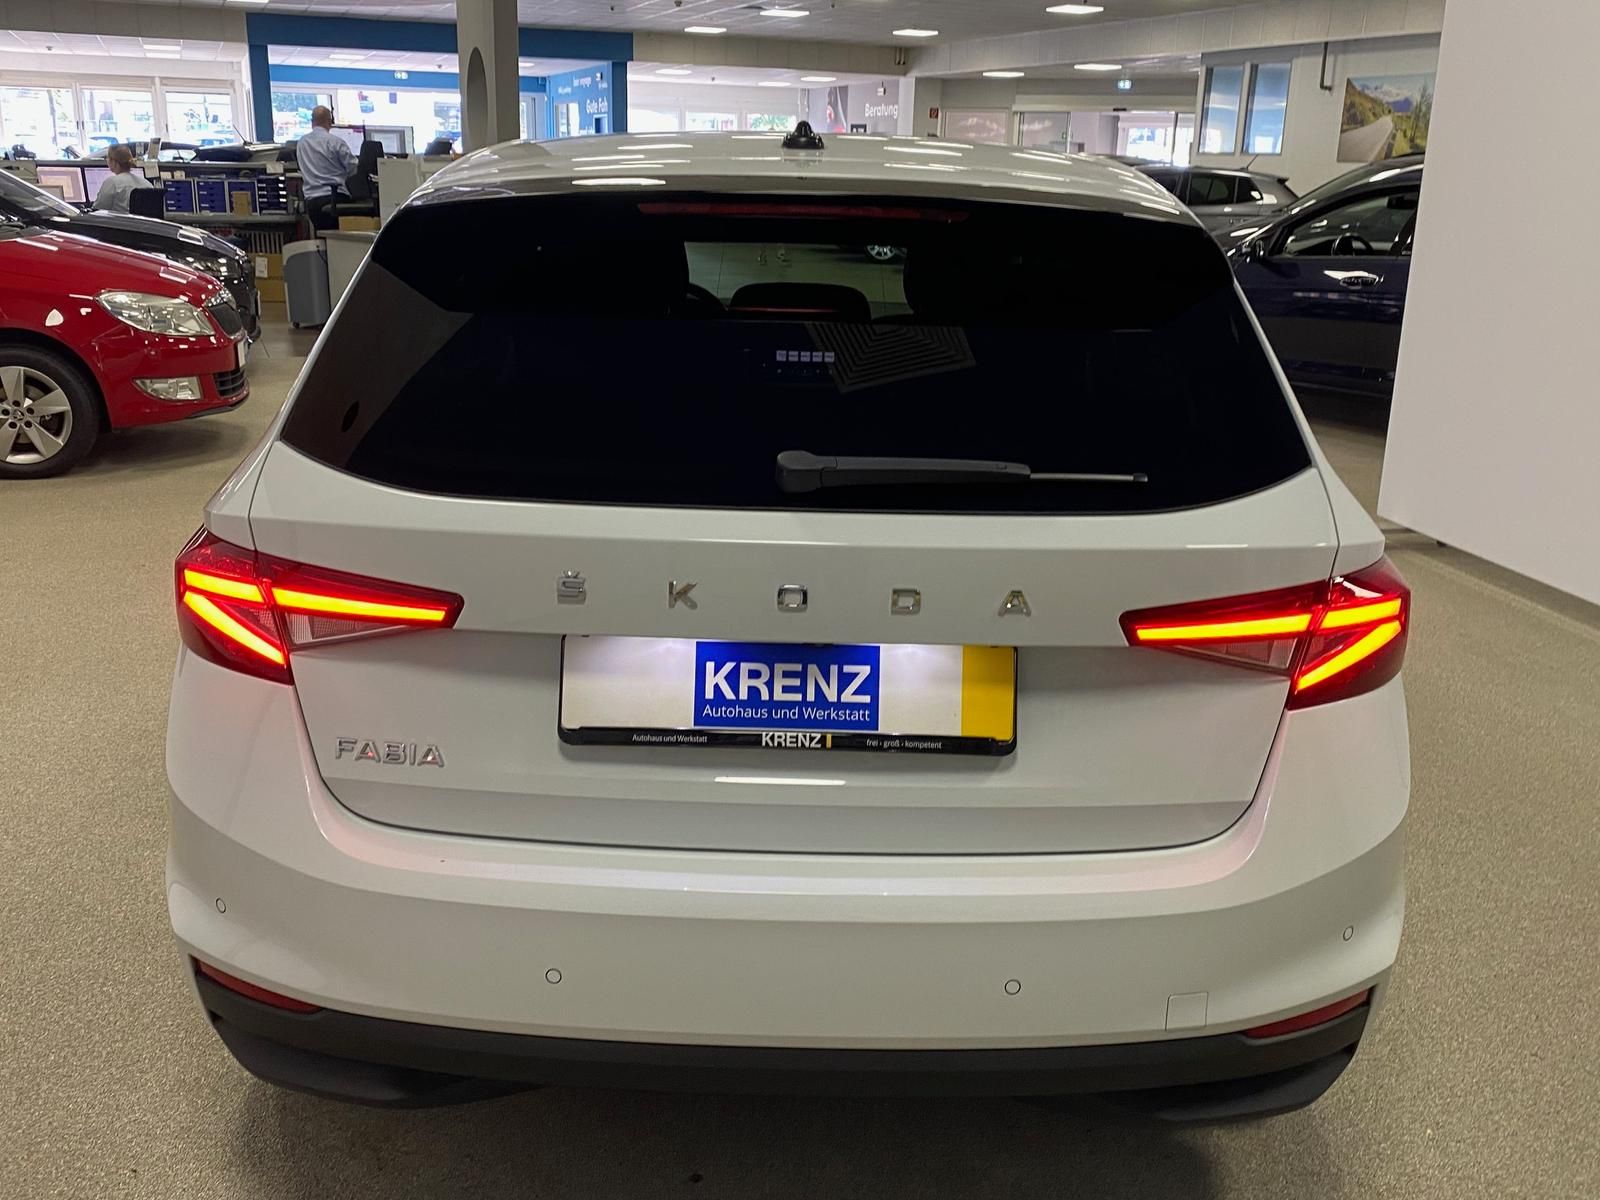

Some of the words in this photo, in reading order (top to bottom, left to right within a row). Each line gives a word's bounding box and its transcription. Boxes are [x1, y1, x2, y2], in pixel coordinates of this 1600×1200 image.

[865, 103, 898, 119] Beratung
[704, 660, 871, 704] KRENZ
[702, 704, 768, 718] Autohaus
[772, 706, 799, 719] und
[803, 706, 870, 721] Werkstatt
[632, 734, 663, 743] Autohaus
[663, 735, 677, 743] und
[677, 735, 708, 743] Werkstatt
[761, 731, 822, 748] KRENZ
[866, 738, 879, 747] frei
[883, 739, 900, 748] groß
[904, 740, 942, 749] kompetent
[335, 736, 445, 768] FABIA
